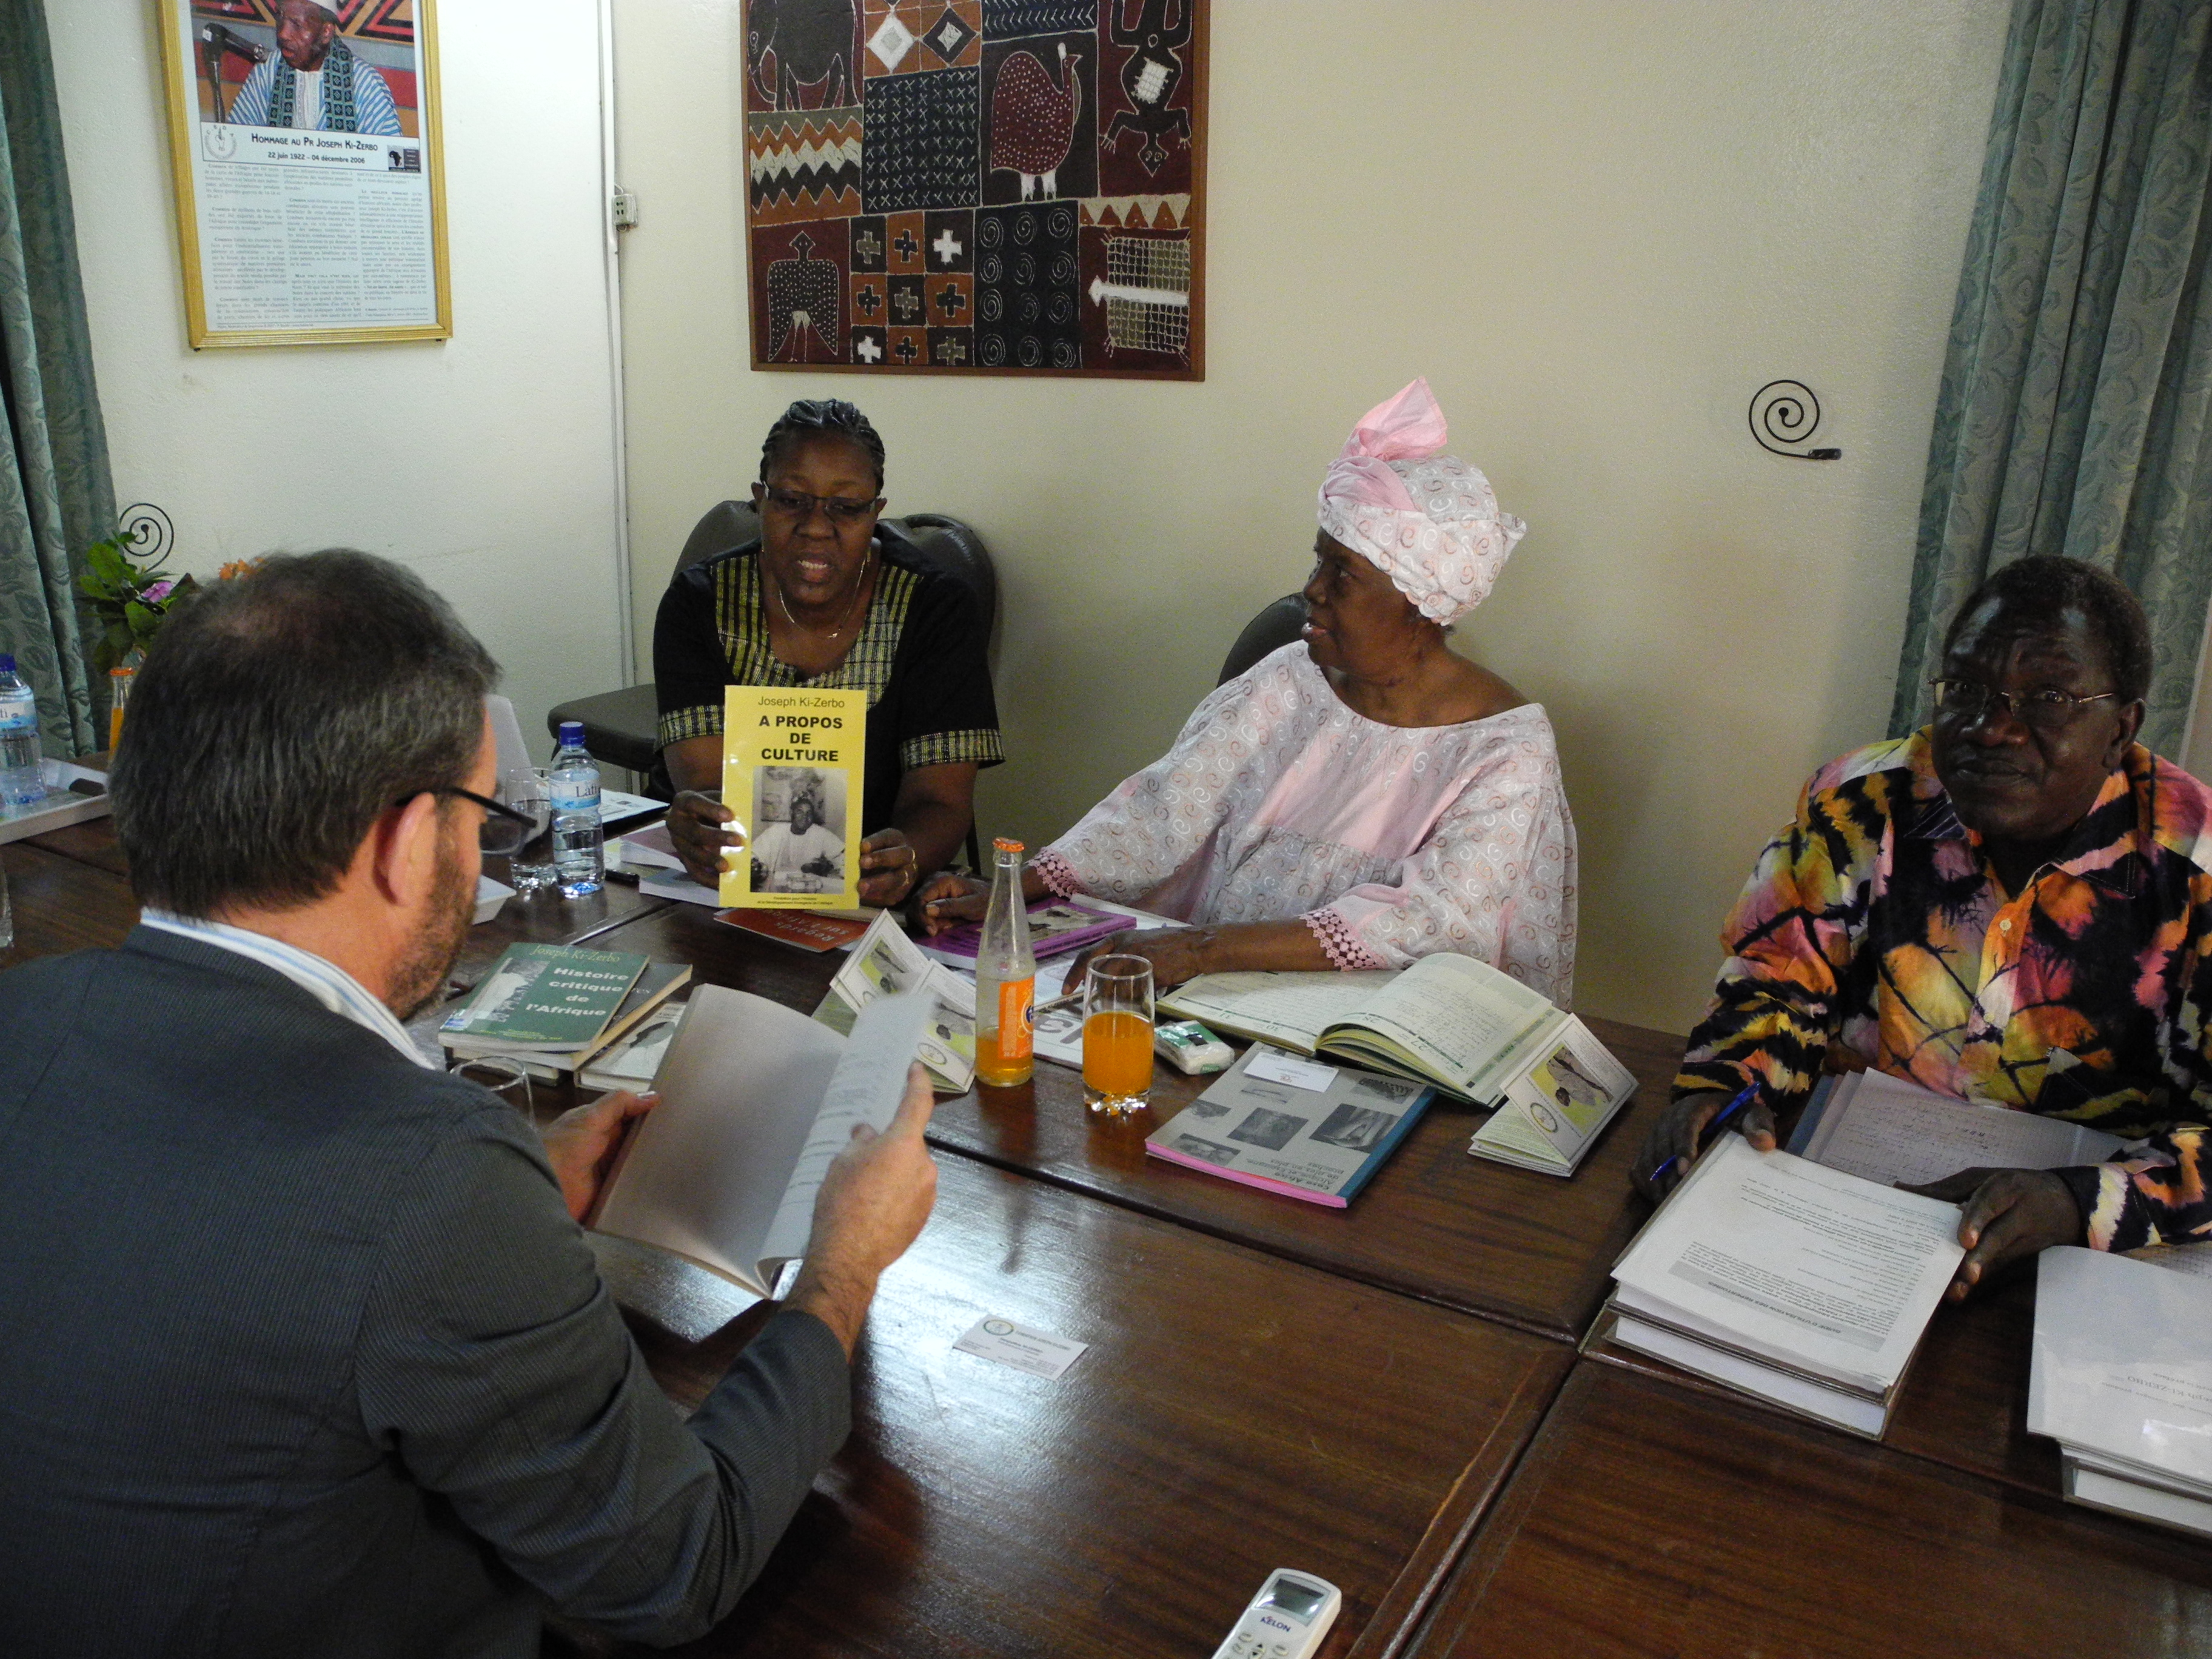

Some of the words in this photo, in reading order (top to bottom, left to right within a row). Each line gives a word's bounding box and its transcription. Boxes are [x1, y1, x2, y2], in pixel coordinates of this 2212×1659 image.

[317, 138, 343, 149] JOSEPH
[345, 139, 378, 151] KI-ZERBO
[321, 155, 349, 163] décembre
[758, 696, 796, 708] Joseph
[799, 697, 845, 708] Ki-Zerbo
[759, 715, 770, 726] A
[776, 716, 843, 729] PROPOS
[789, 732, 811, 745] DE
[761, 748, 839, 762] CULTURE
[529, 943, 569, 959] Joseph
[571, 949, 620, 962] Ki-Zerbo
[553, 967, 629, 980] Histoire
[549, 981, 623, 992] critique
[525, 1003, 606, 1016] l'Afrique
[1410, 1040, 1427, 1051] 27
[2127, 1375, 2184, 1398] KI-ZERBO
[1260, 1616, 1291, 1632] KELON
